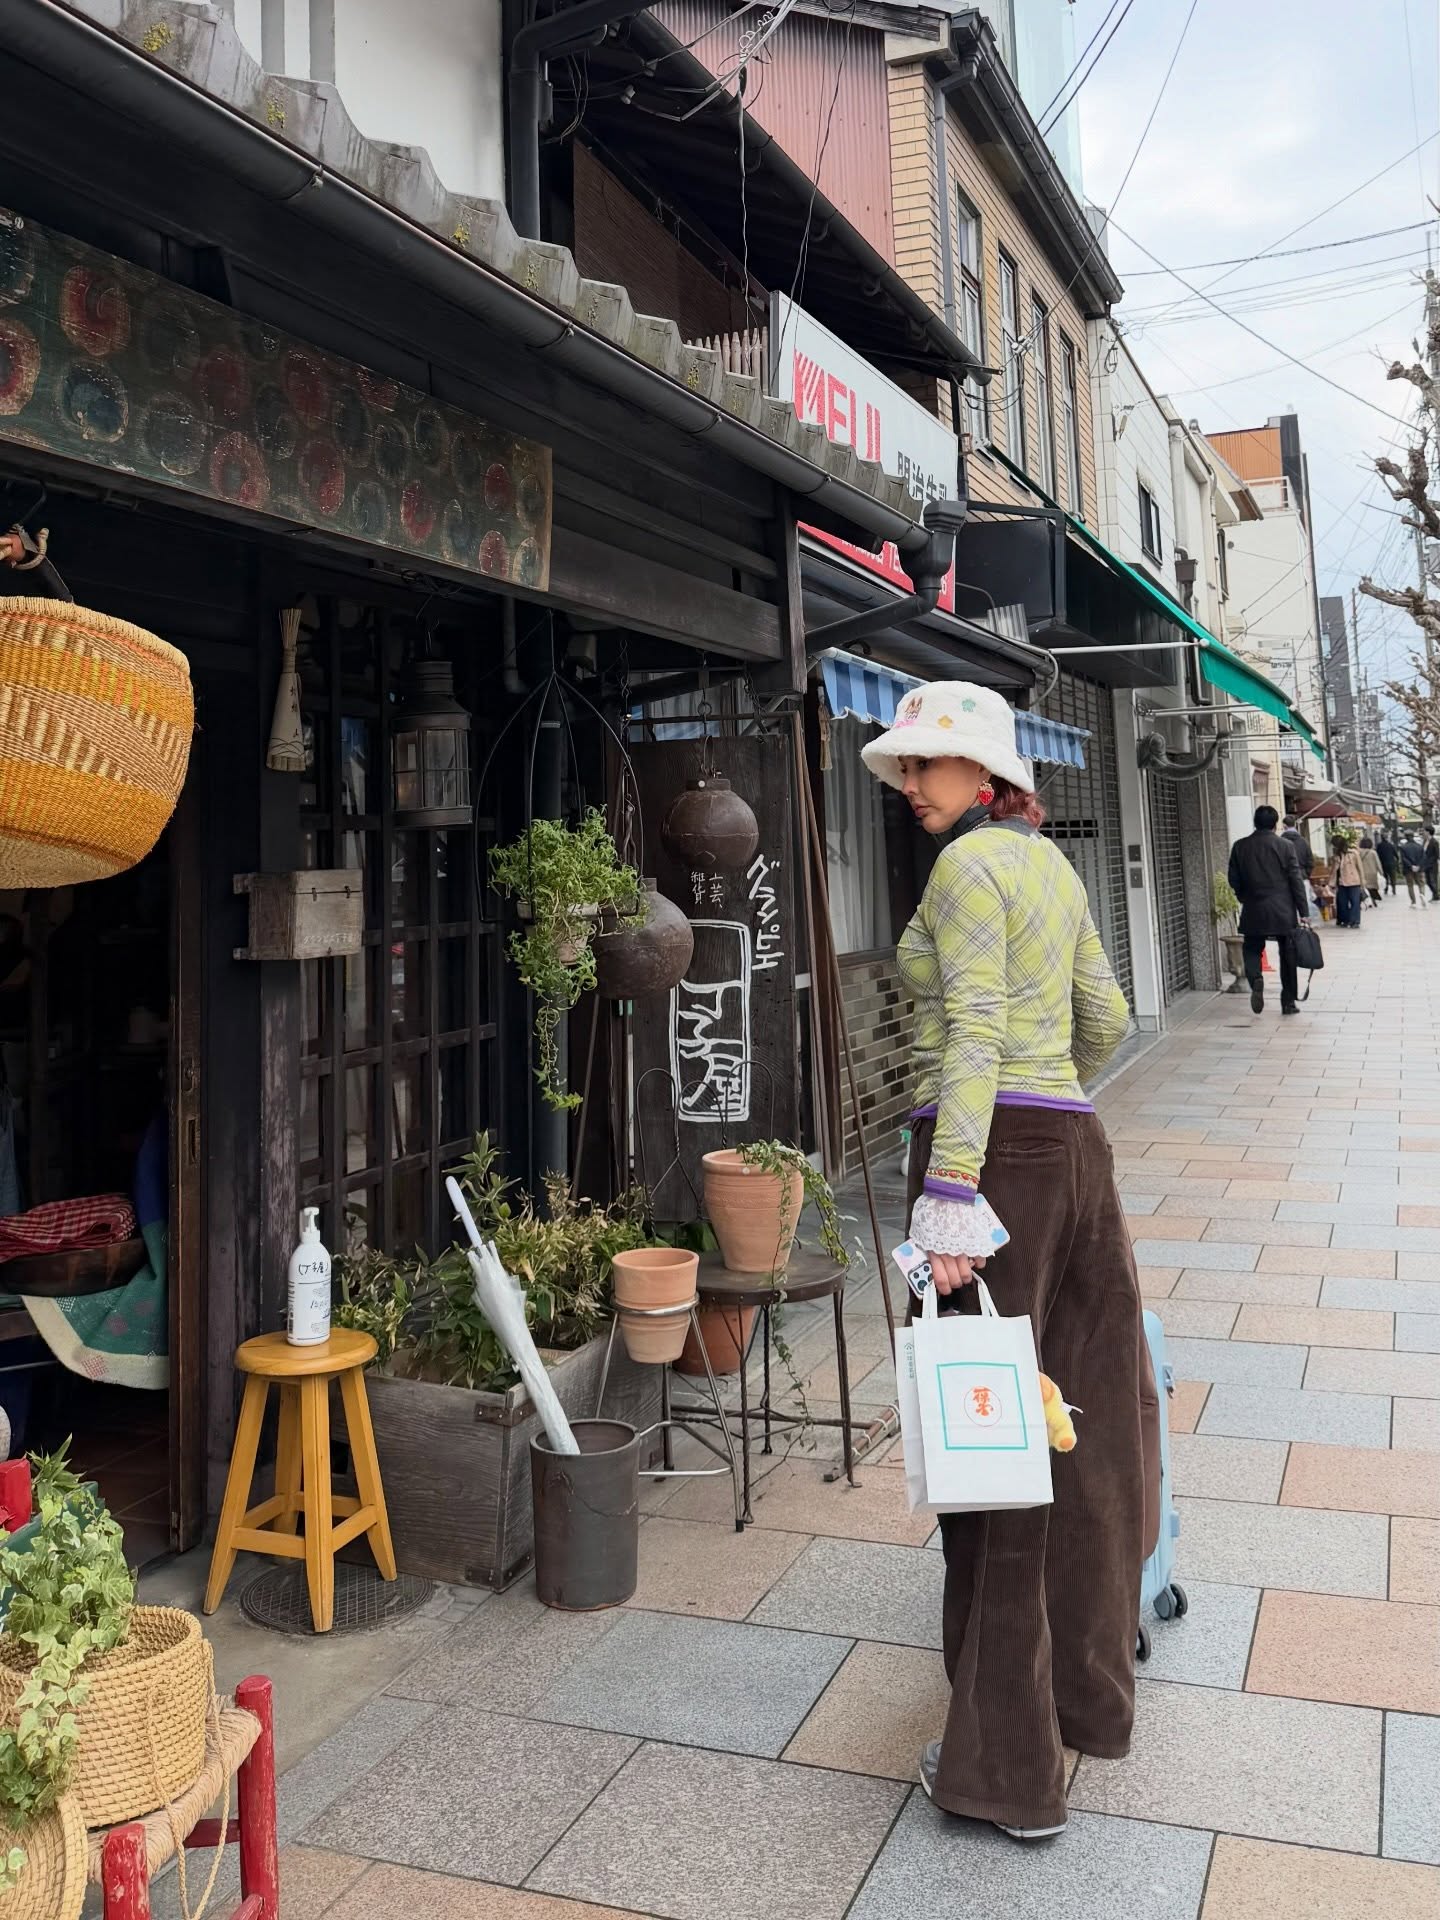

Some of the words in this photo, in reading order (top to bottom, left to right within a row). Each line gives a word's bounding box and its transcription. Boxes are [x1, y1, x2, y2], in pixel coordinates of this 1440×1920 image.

[746, 853, 785, 971] グランピエ
